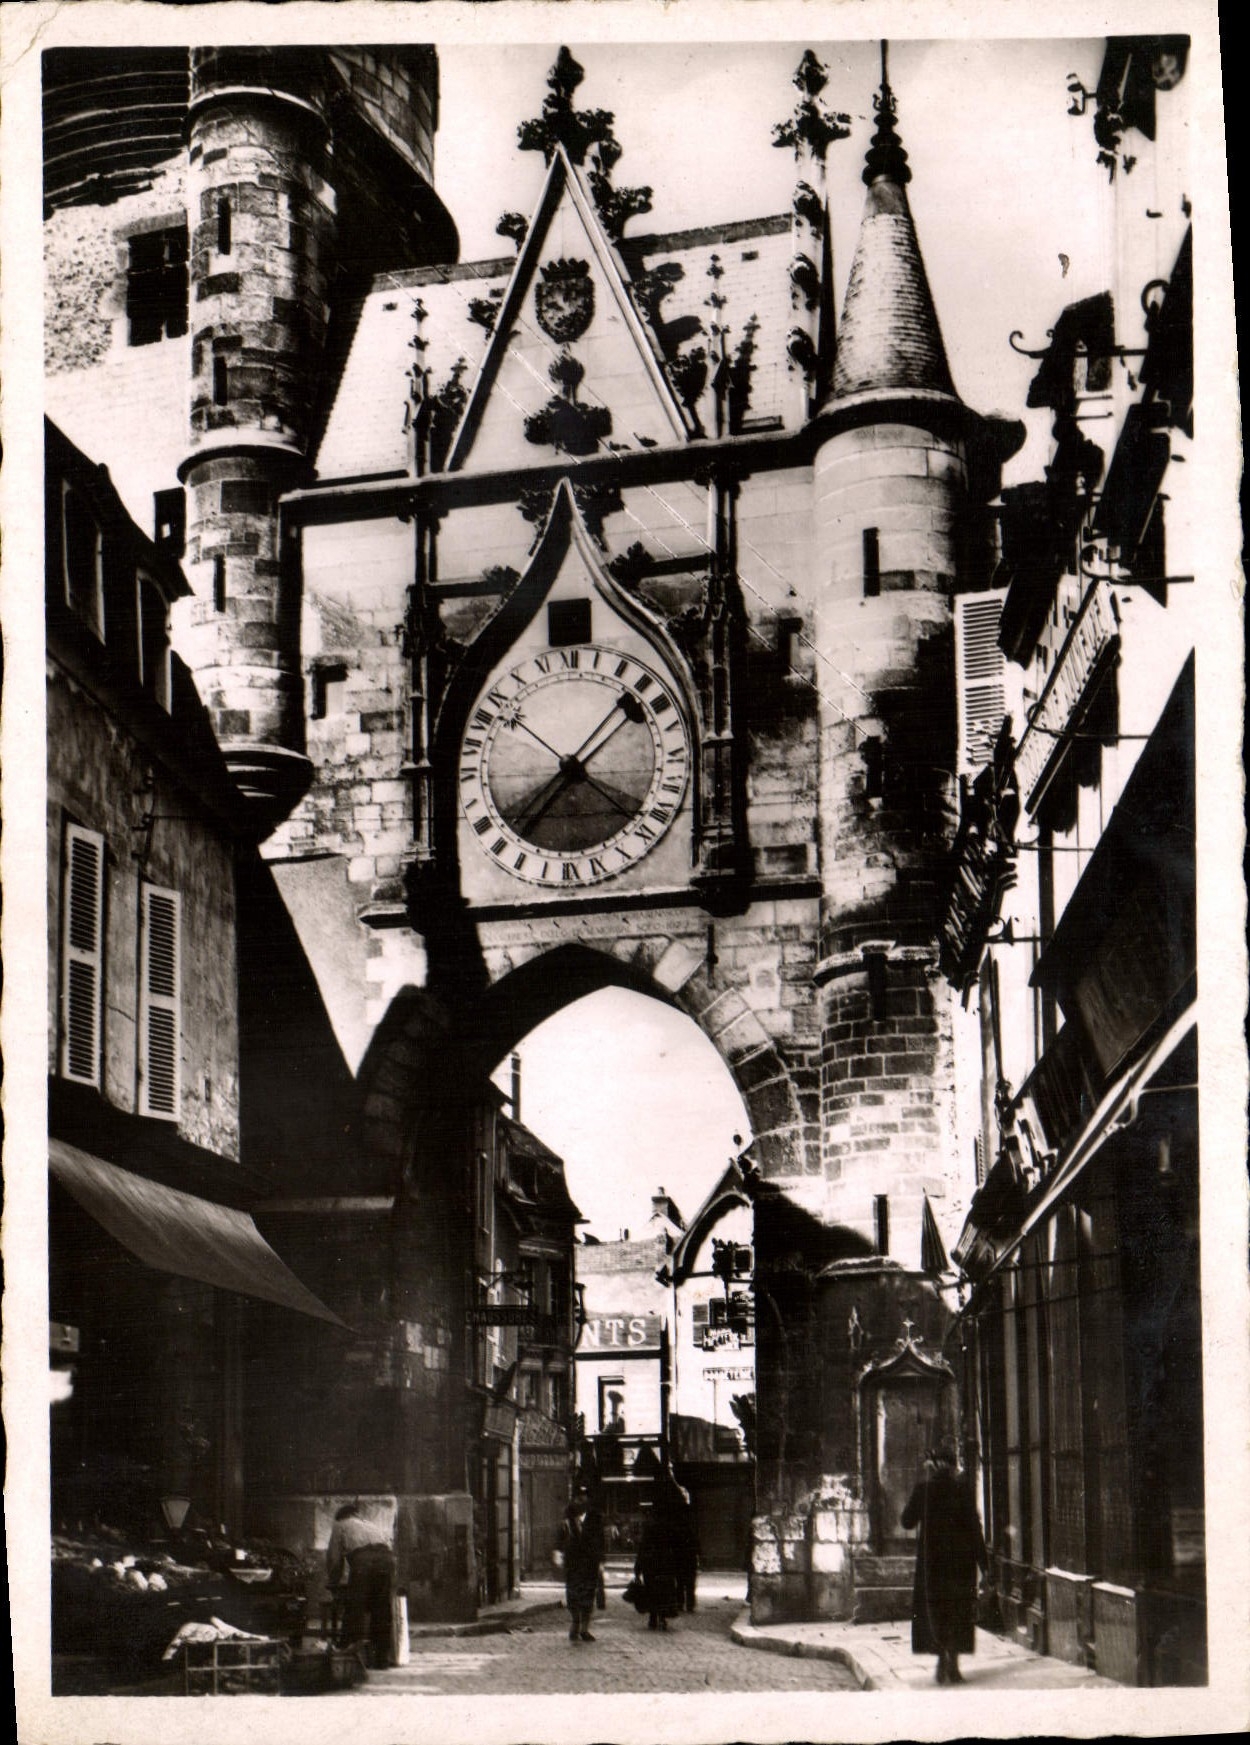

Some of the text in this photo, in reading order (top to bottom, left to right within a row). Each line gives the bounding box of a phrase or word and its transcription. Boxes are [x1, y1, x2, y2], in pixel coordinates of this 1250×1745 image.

[559, 650, 579, 669] XII
[593, 652, 600, 669] I
[614, 660, 628, 678] II
[514, 852, 526, 871] II
